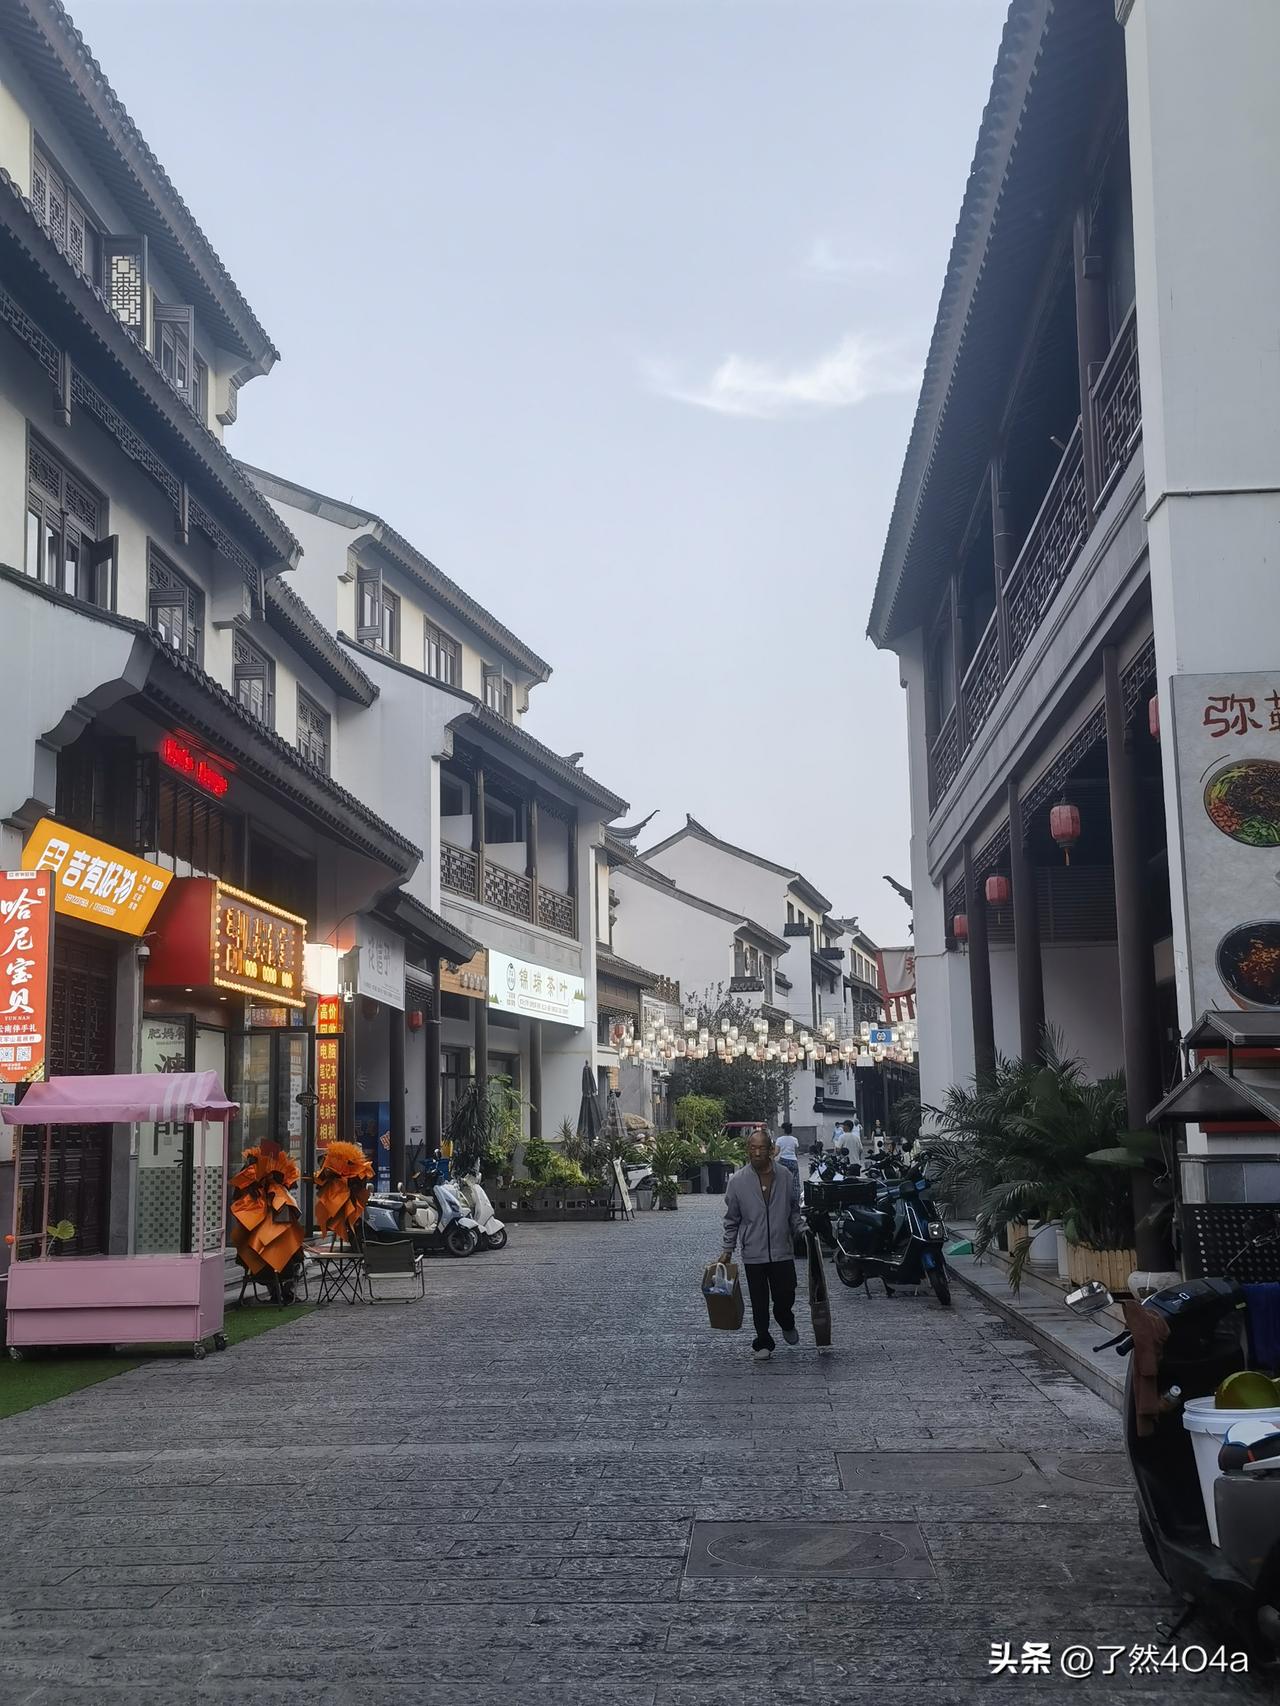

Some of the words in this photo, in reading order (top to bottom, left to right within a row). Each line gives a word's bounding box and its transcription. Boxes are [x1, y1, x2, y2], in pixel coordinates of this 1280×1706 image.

[1202, 688, 1280, 738] 弥
[0, 888, 42, 1015] 哈尼宝贝
[319, 1003, 337, 1020] 高价
[319, 1042, 337, 1059] 电脑
[319, 1063, 337, 1080] 笔记本
[319, 1083, 337, 1099] 手机
[319, 1123, 337, 1140] 相机
